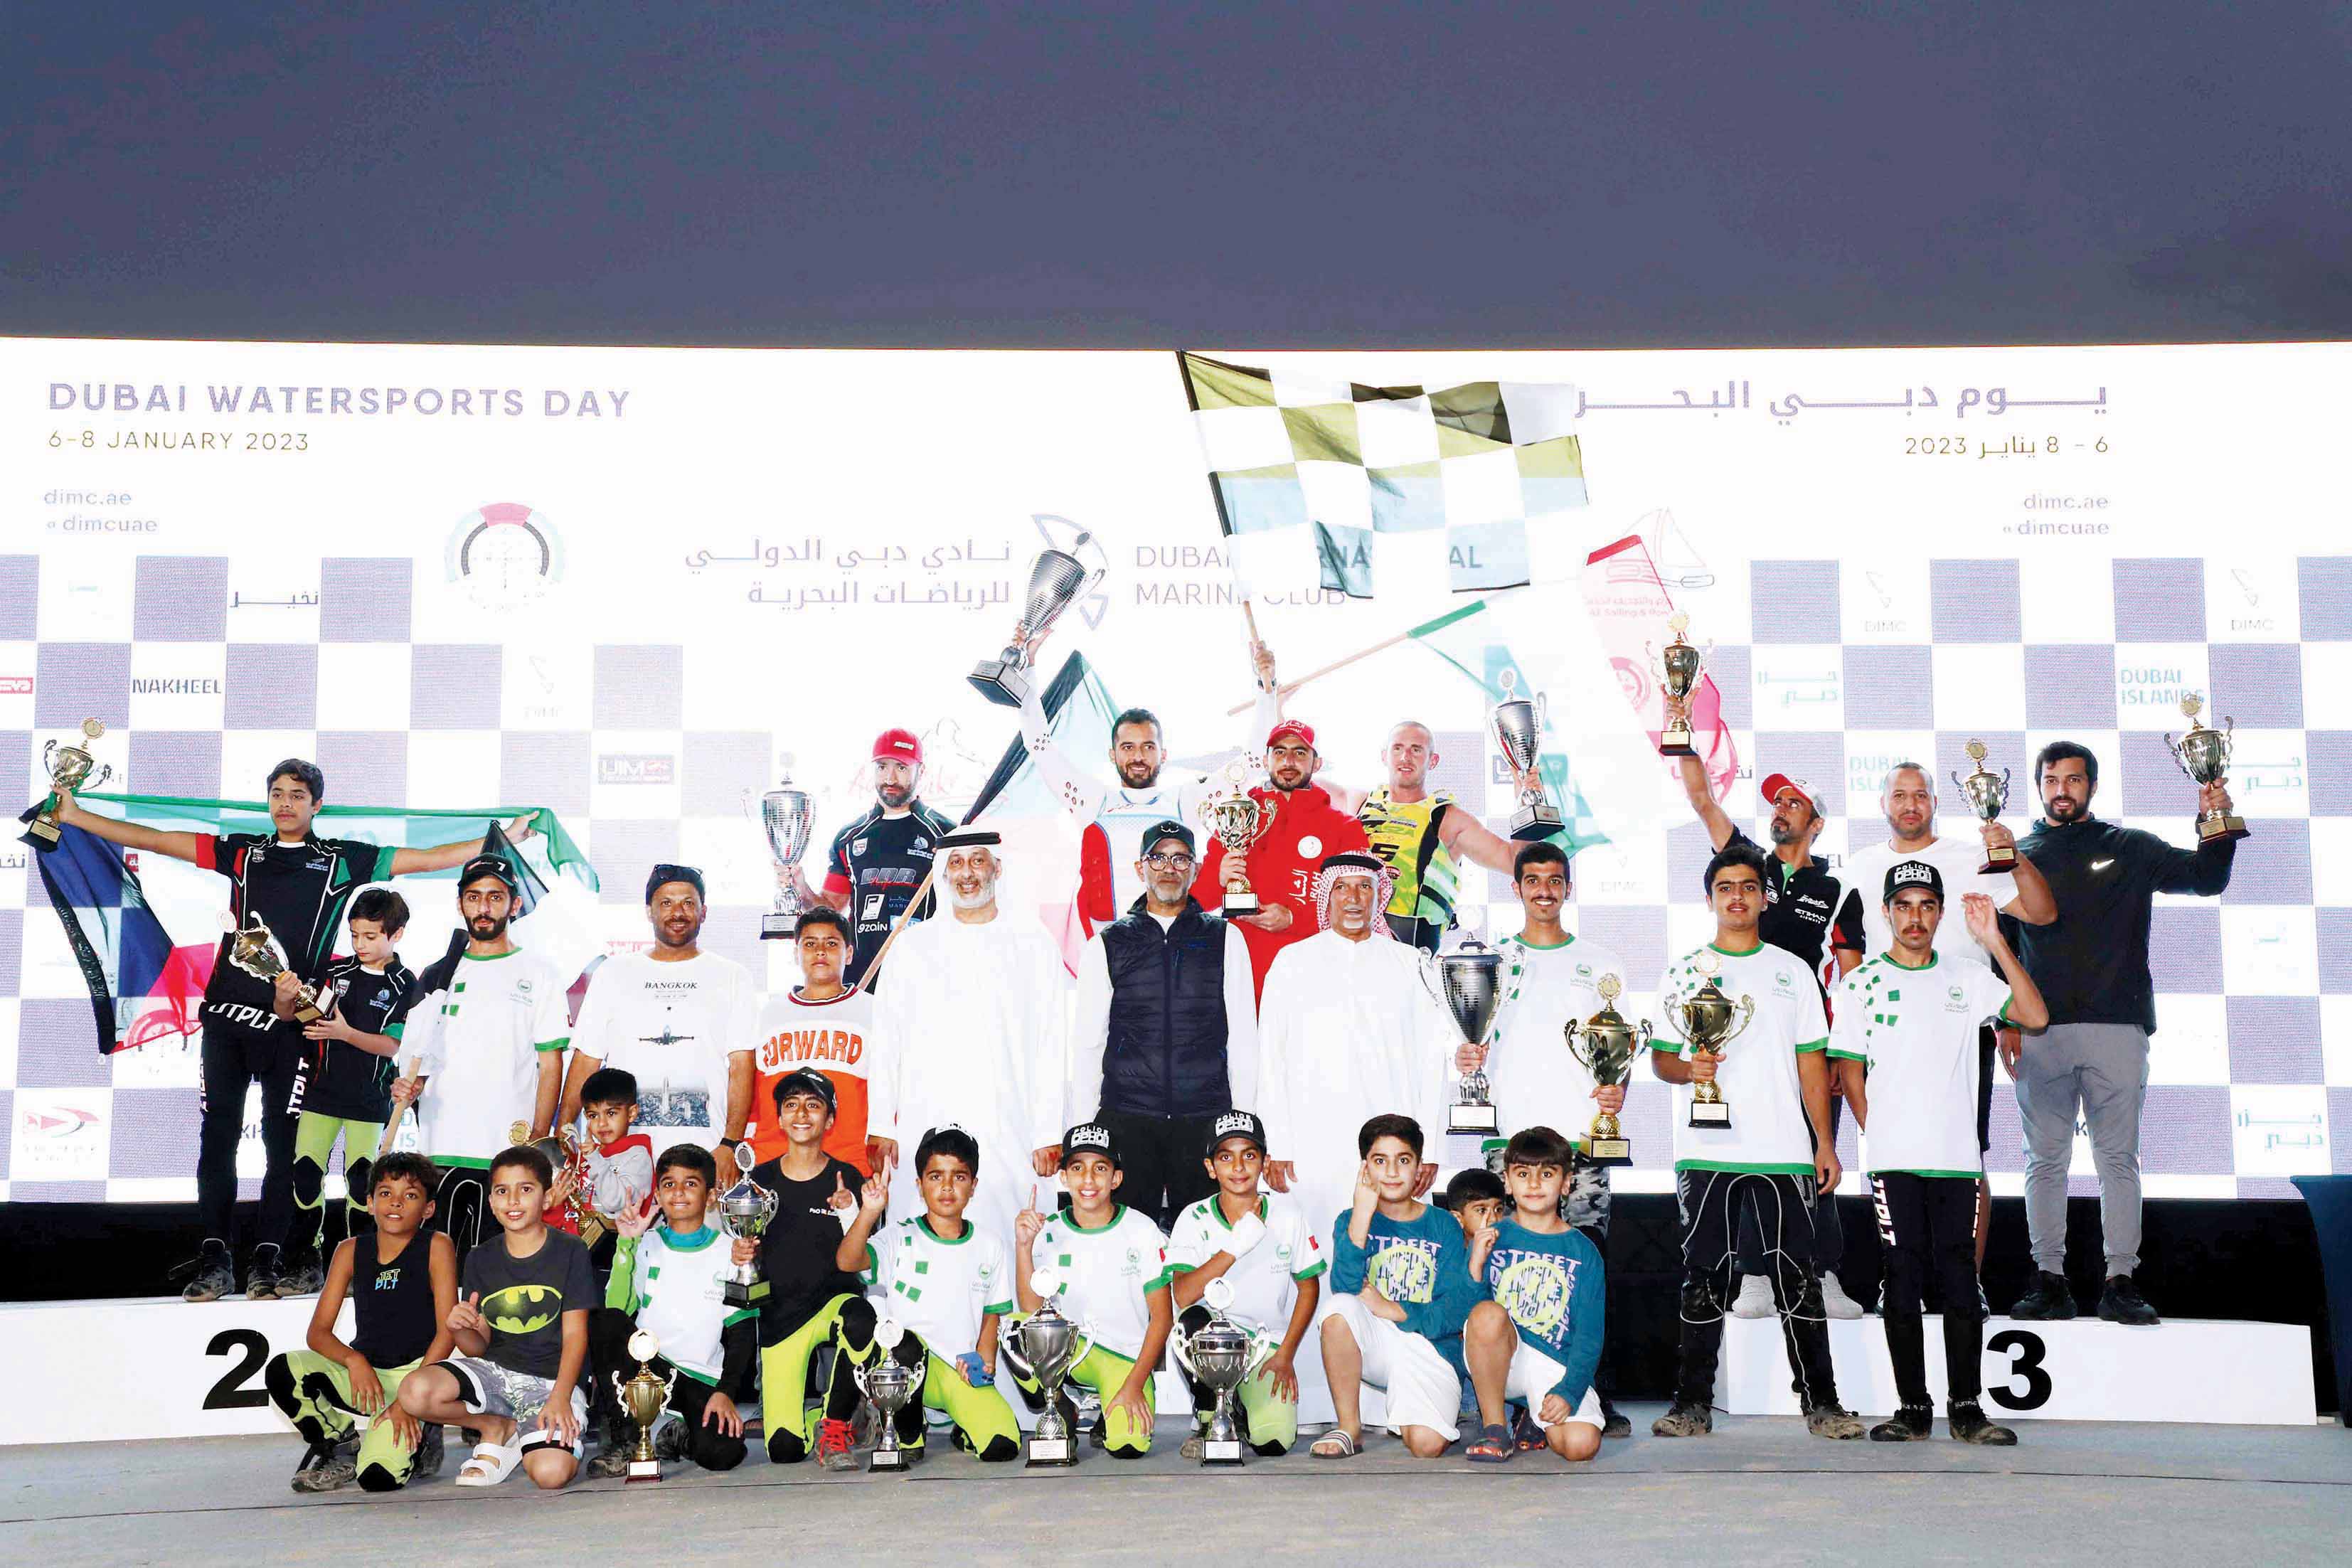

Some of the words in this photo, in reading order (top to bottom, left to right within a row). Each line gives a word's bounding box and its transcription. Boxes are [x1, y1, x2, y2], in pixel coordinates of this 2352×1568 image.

[49, 383, 186, 412] DUBAI
[208, 386, 523, 416] WATERSPORTS
[544, 390, 630, 417] DAY
[1575, 380, 1749, 419] البحر
[1770, 386, 1938, 426] دبي
[1957, 386, 2107, 419] يوم
[107, 431, 233, 450] JANUARY
[246, 432, 309, 451] 2023
[1905, 437, 1967, 454] 2023
[1978, 434, 2036, 459] يناير
[2047, 436, 2059, 454] 8
[2095, 436, 2109, 453] 6
[44, 489, 132, 506] dimc.ae
[2023, 494, 2109, 510] dimc.ae
[63, 515, 158, 532] dimcuae
[2018, 519, 2110, 535] dimcuae
[685, 538, 821, 575] الدولي
[836, 545, 907, 575] دبي
[922, 539, 1009, 575] نادي
[230, 591, 319, 609] نخيل
[747, 580, 858, 610] البحرية
[873, 580, 1010, 610] للرياضات
[1136, 583, 1242, 604] MARIN
[2230, 619, 2274, 631] DIMC
[2120, 669, 2182, 683] DUBAI
[132, 678, 222, 694] NAKHEEL
[1896, 863, 1930, 872] POLICE
[1794, 907, 1826, 922] ETIHAD
[644, 981, 698, 990] BANGKOK
[762, 1029, 862, 1068] FORWARD
[1215, 1111, 1251, 1123] POLICE
[1073, 1126, 1109, 1136] POLICE
[1491, 1249, 1582, 1274] STREET
[202, 1329, 270, 1409] 2
[1986, 1330, 2053, 1411] 3
